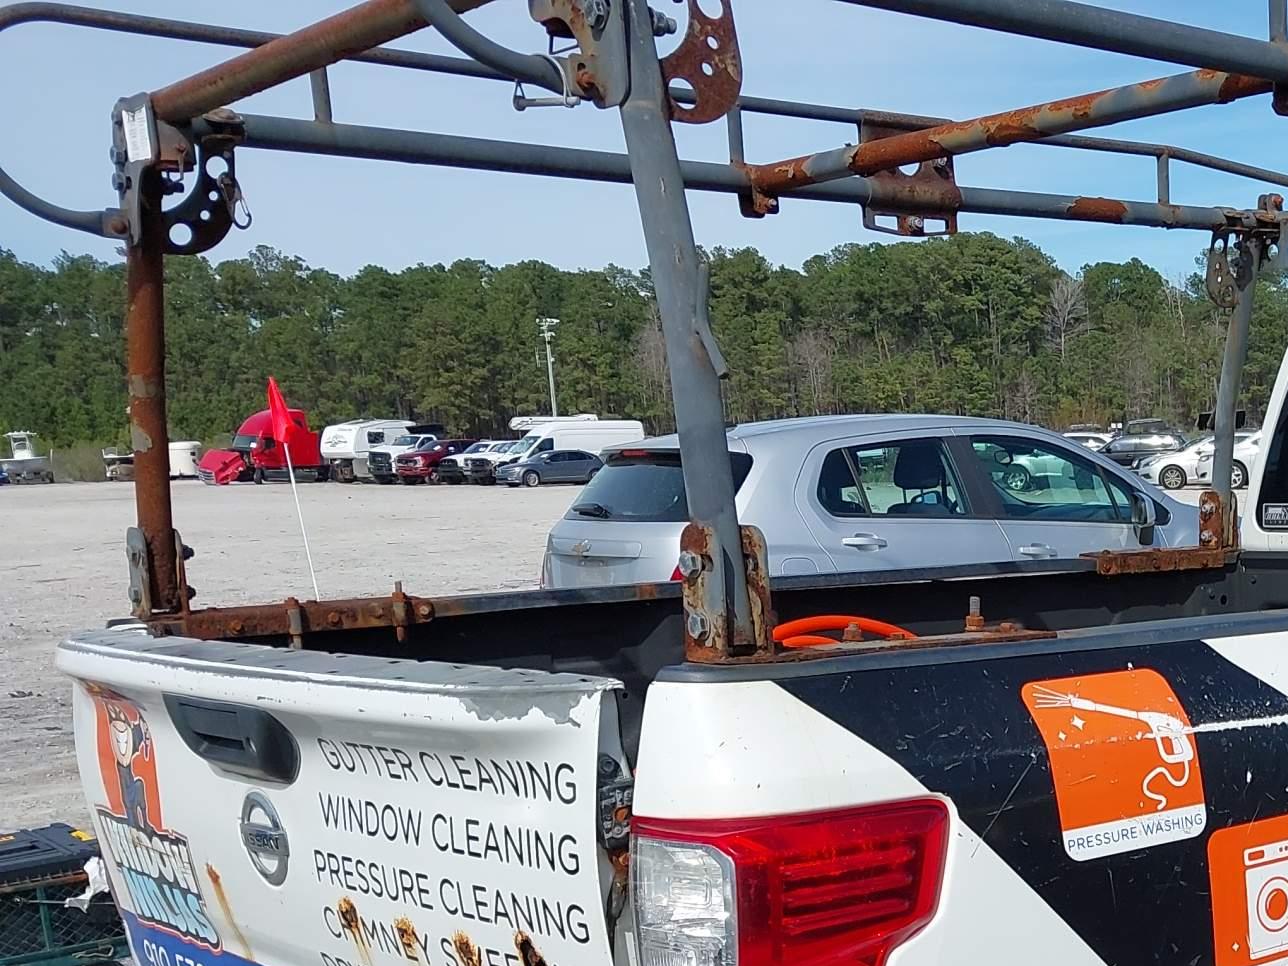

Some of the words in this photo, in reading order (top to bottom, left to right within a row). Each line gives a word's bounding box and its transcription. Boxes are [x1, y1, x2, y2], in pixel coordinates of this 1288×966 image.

[317, 737, 418, 782] GUTTER
[419, 751, 577, 805] CLEANING
[100, 815, 200, 895] WINDOW
[319, 792, 421, 847] WINDOW
[432, 813, 580, 876] CLEANING
[1067, 826, 1138, 852] PRESSURE
[1141, 813, 1204, 836] WASHING
[121, 866, 219, 944] NINJAS
[314, 849, 433, 911] PRESSURE
[440, 878, 590, 944] CLEANING
